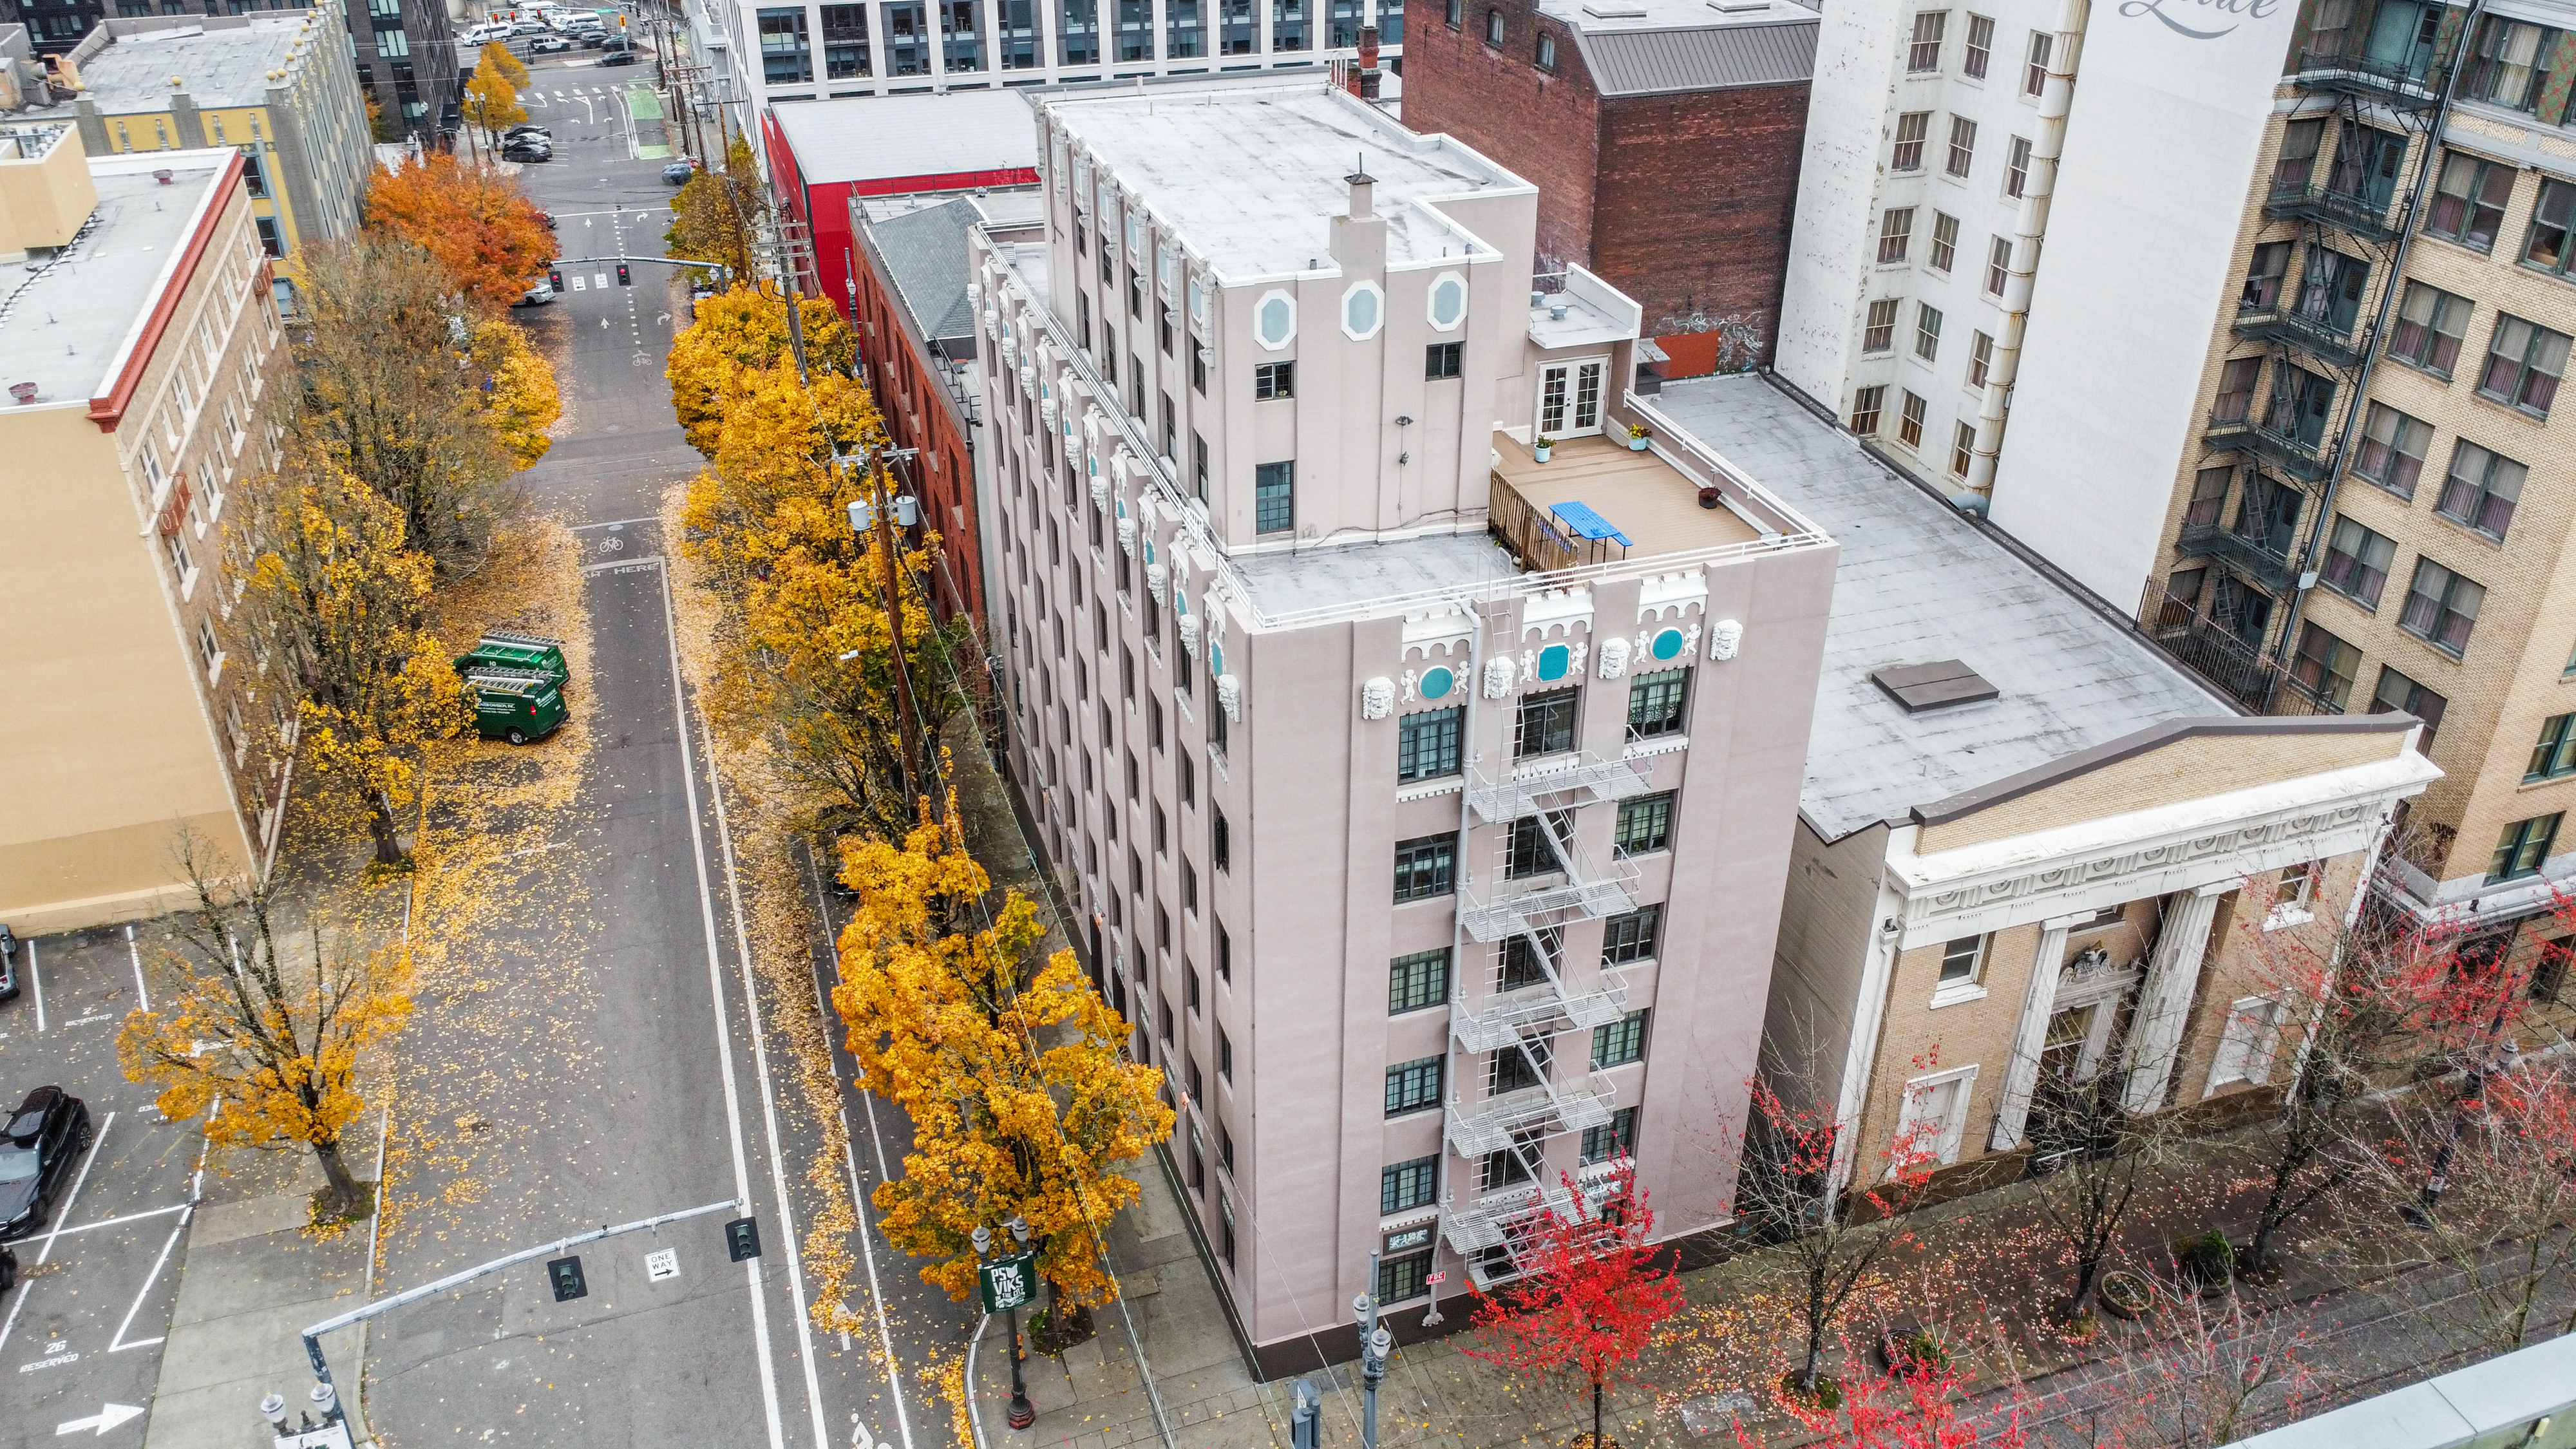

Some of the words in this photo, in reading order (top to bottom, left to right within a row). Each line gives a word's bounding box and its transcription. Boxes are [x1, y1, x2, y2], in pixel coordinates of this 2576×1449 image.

[582, 571, 603, 579] AIT
[614, 562, 659, 574] HERE
[65, 1014, 113, 1027] RESERVED
[651, 1253, 670, 1263] ONE
[652, 1260, 672, 1270] WAY
[1429, 1273, 1443, 1282] FDC
[993, 1274, 1023, 1295] VIKS
[44, 1340, 66, 1354] 26
[19, 1353, 79, 1373] RESERVED
